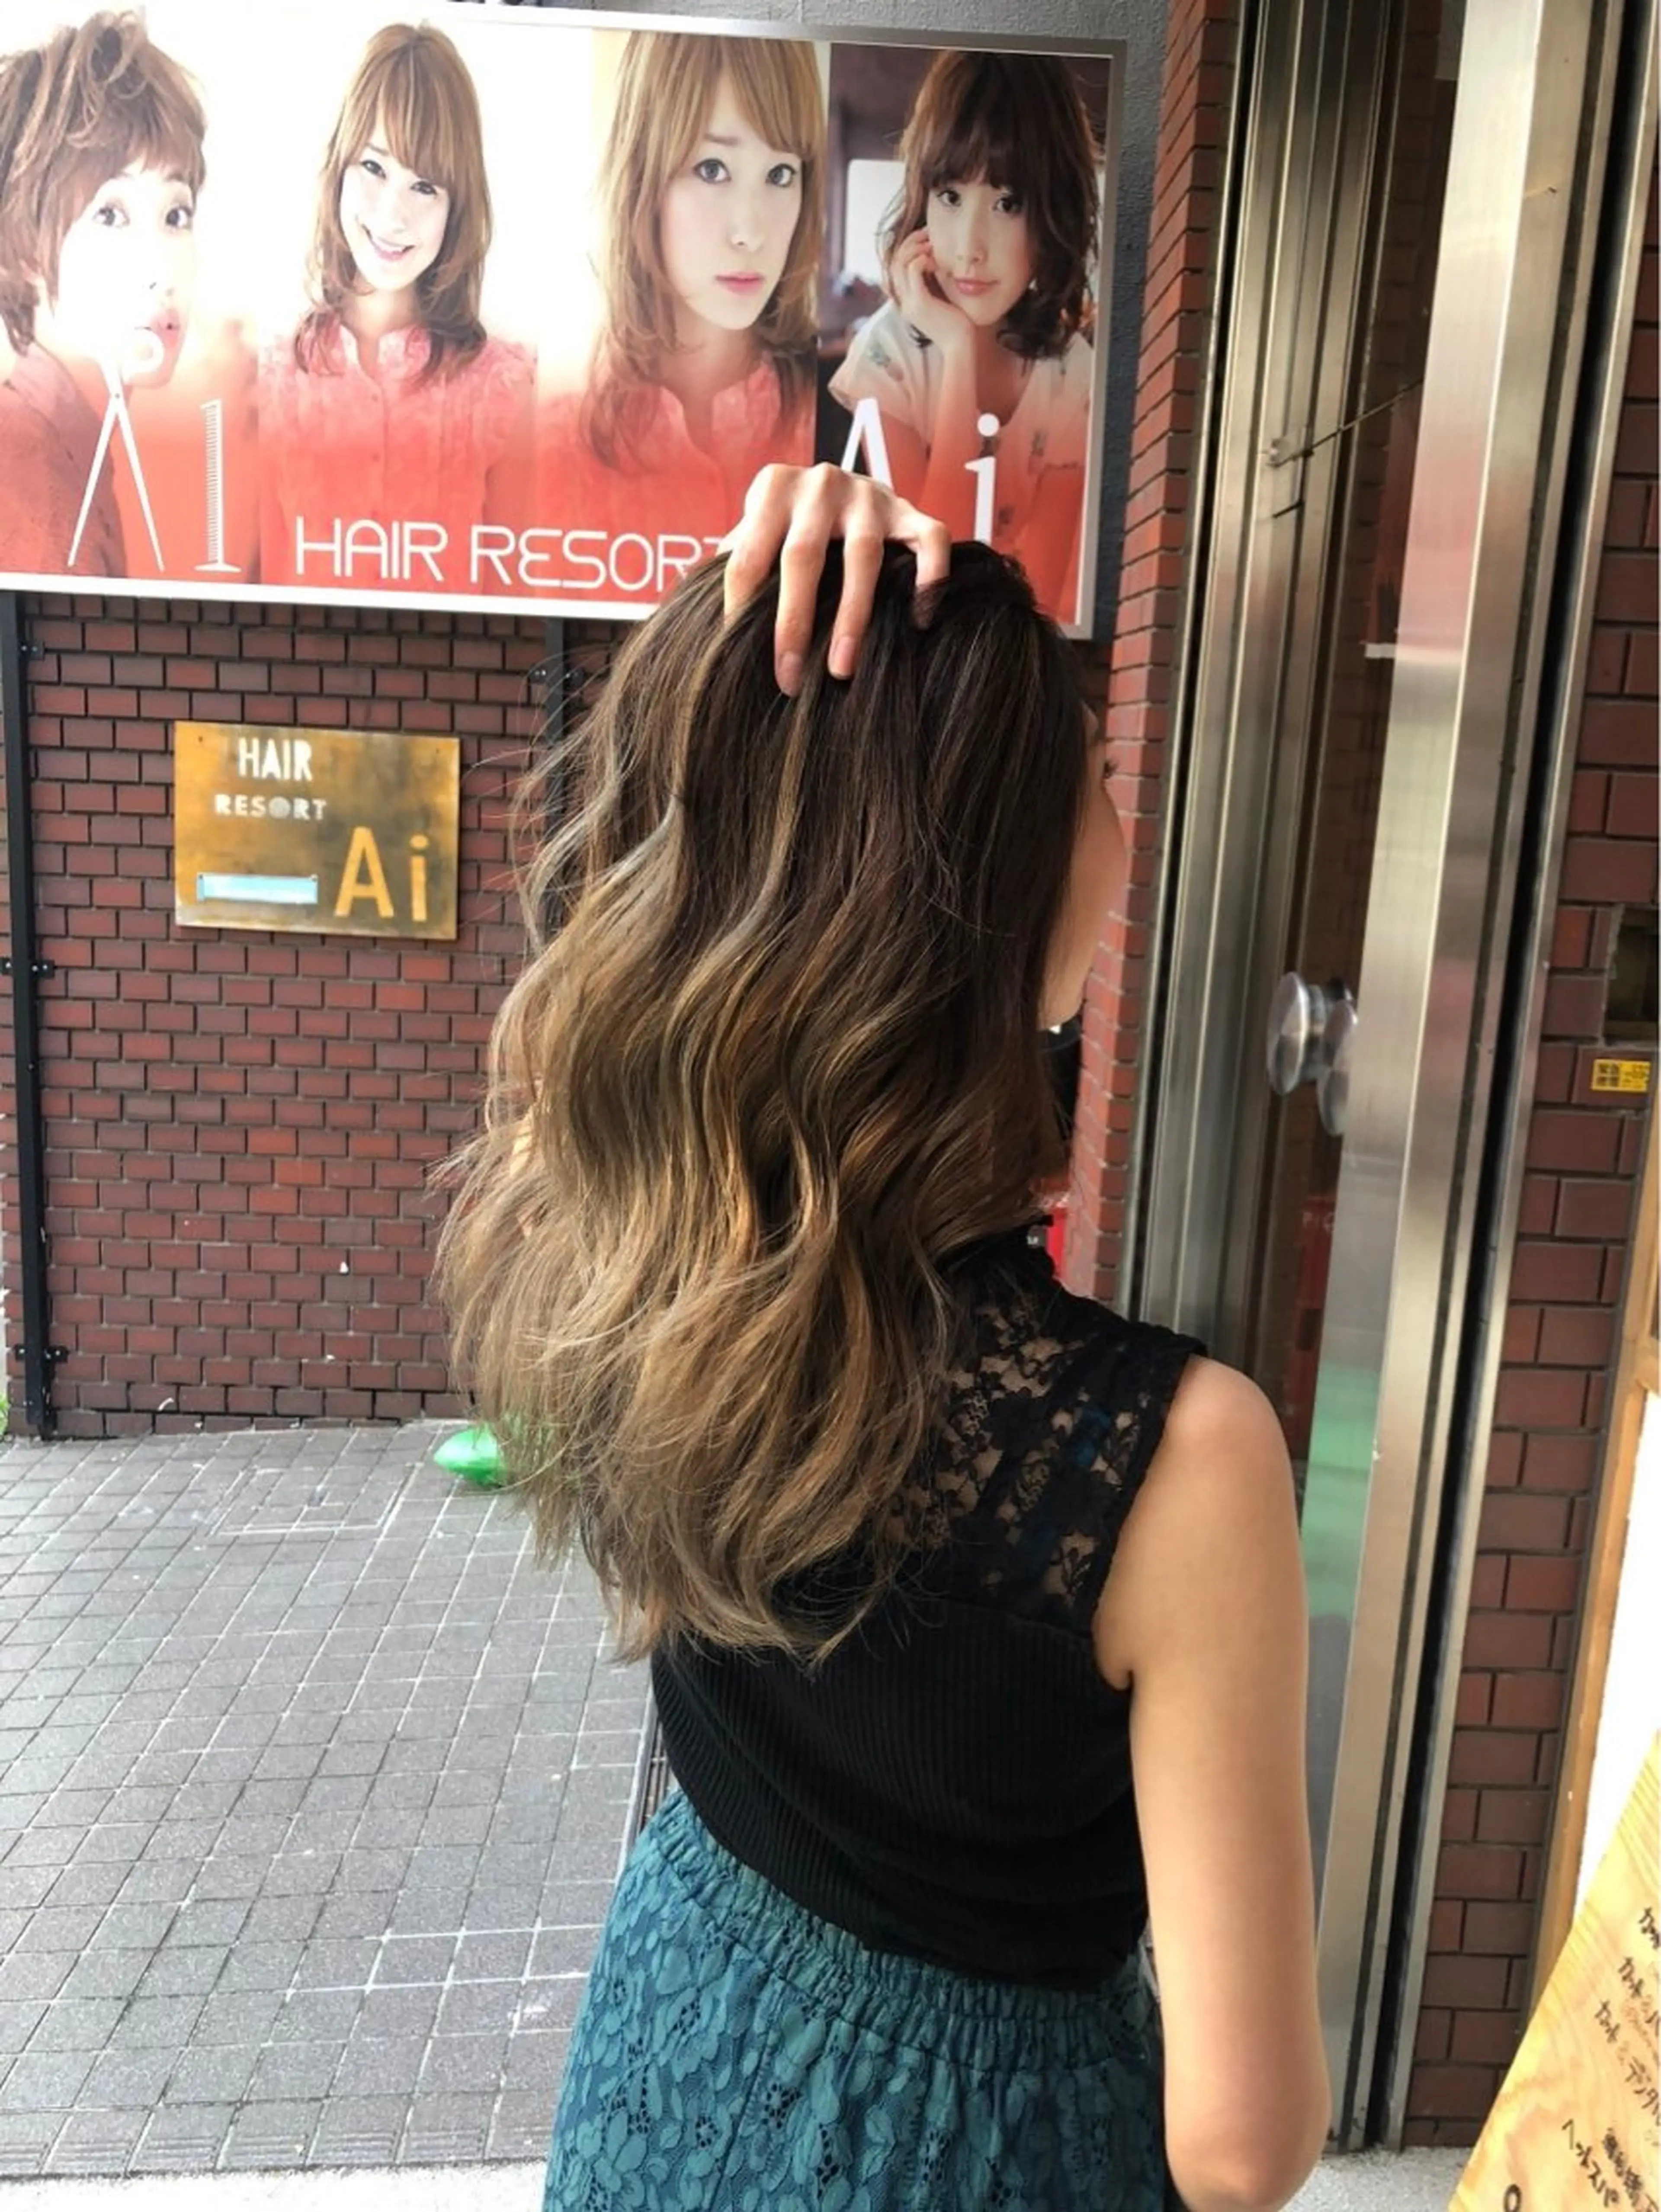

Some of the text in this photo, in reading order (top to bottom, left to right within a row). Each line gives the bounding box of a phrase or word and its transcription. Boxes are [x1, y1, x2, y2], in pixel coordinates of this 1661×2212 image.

[296, 515, 448, 581] HAIR
[238, 737, 313, 781] HAIR
[214, 794, 327, 820] RESORT
[334, 826, 429, 922] Ai
